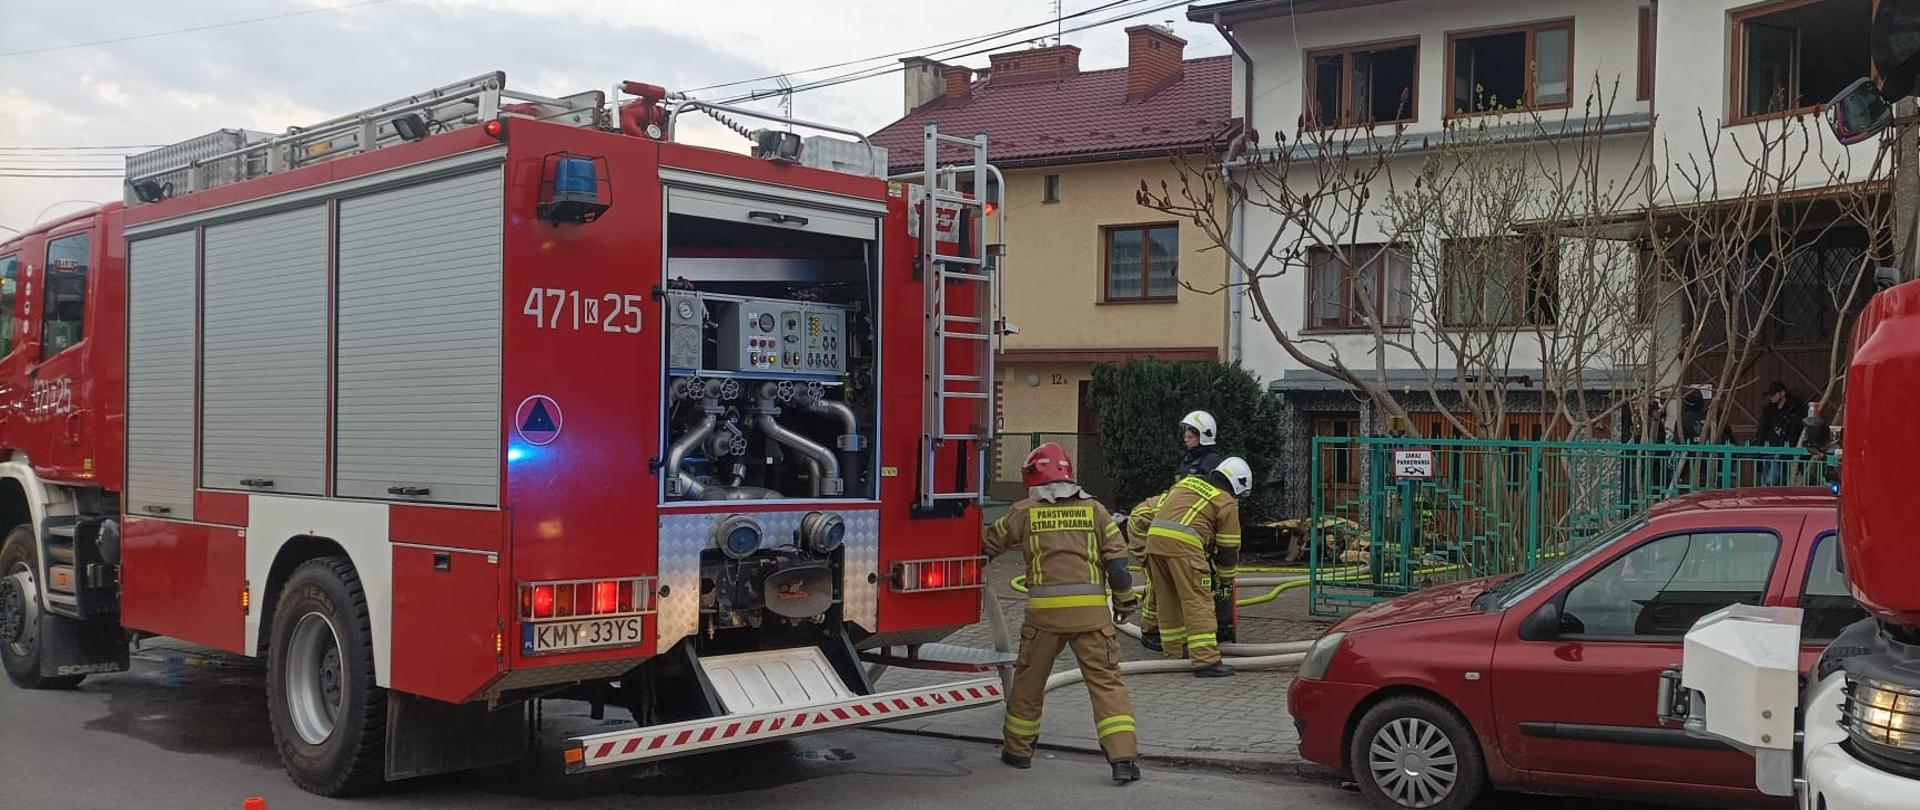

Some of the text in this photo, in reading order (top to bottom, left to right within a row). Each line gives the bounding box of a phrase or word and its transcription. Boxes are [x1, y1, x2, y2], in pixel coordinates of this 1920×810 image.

[524, 287, 579, 330] 471
[603, 293, 642, 334] 25
[56, 377, 71, 414] 25
[537, 619, 638, 648] KMY 33YS
[57, 662, 120, 675] SCANIA
